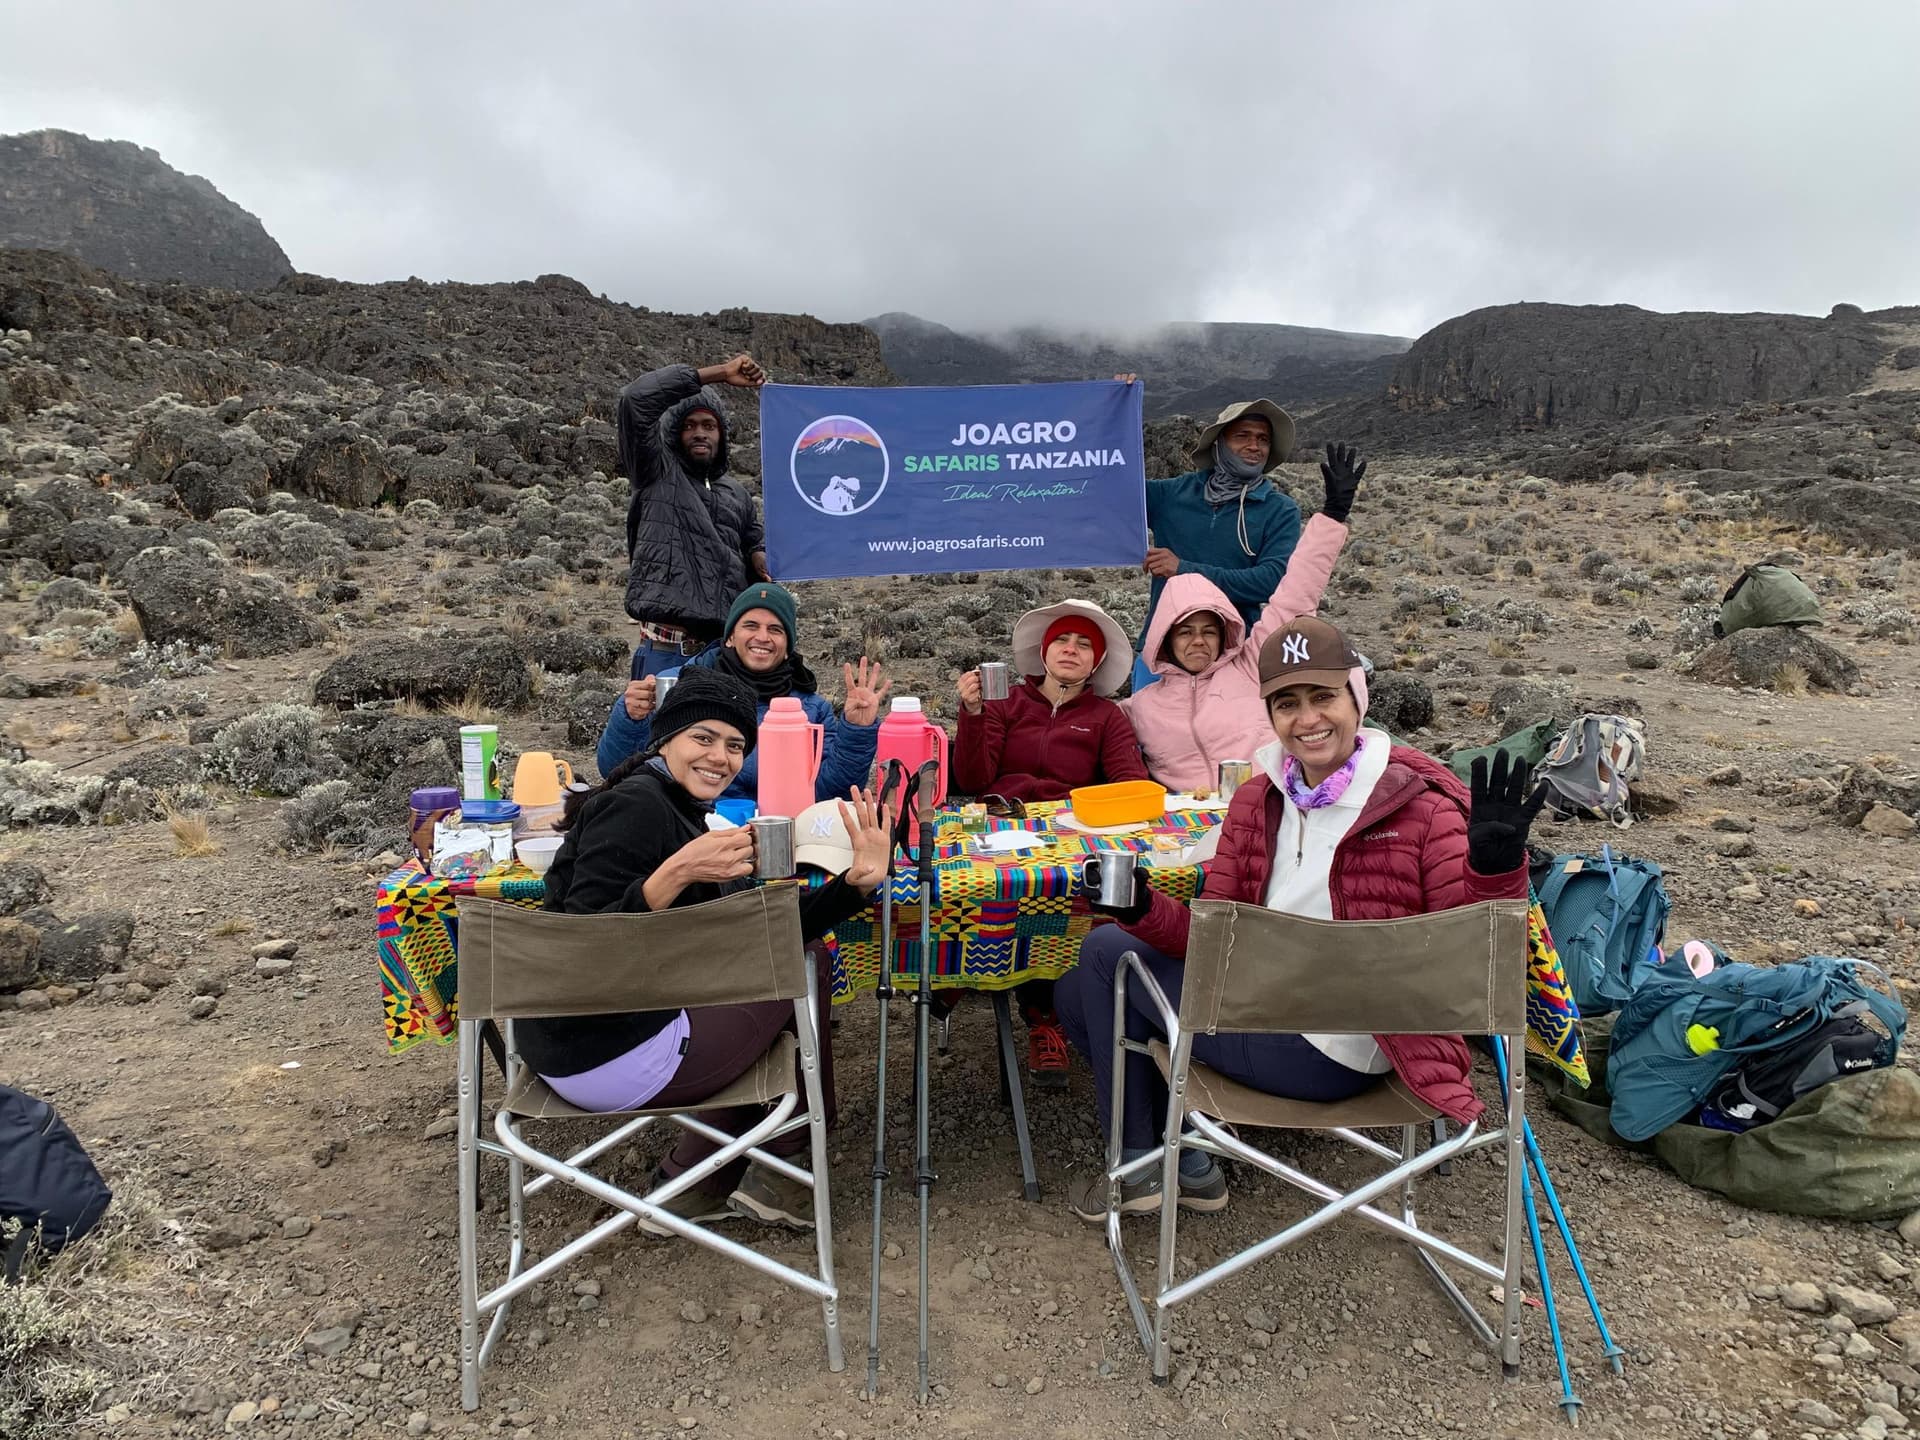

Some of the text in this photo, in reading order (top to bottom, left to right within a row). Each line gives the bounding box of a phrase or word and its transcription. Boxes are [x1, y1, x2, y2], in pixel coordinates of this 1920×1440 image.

[951, 420, 1077, 446] JOAGRO
[904, 449, 1126, 473] SAFARIS TANZANIA
[943, 480, 1088, 503] Ideal Relaxation!
[868, 535, 1045, 553] www.joagrosafaris.com
[1282, 633, 1310, 664] NY
